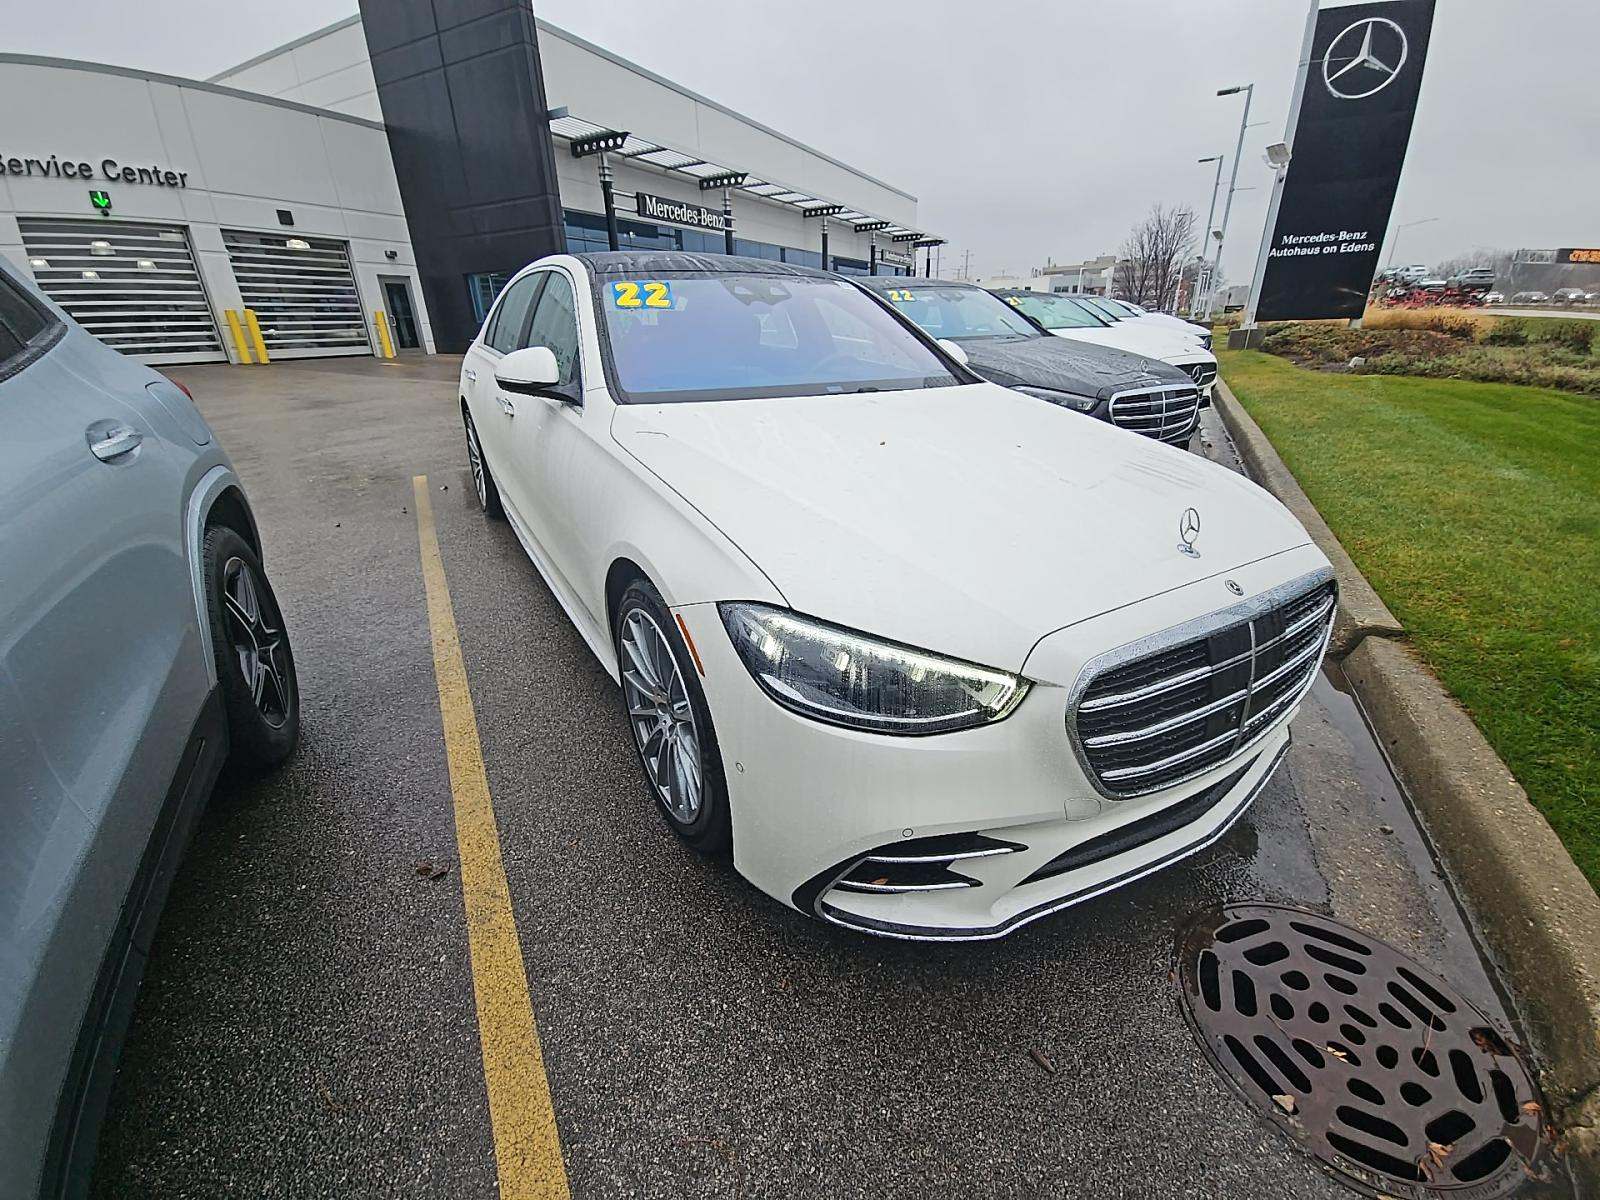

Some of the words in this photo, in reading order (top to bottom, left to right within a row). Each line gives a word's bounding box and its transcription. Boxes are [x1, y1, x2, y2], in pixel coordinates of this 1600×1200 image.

[102, 159, 187, 188] Center
[645, 195, 725, 228] Mercedes-Benz
[1281, 230, 1368, 245] Mercedes-Benz
[1269, 246, 1320, 257] Autohaus
[1323, 245, 1337, 254] on
[1340, 242, 1375, 253] Edens
[614, 282, 672, 308] 22
[887, 290, 916, 302] 22
